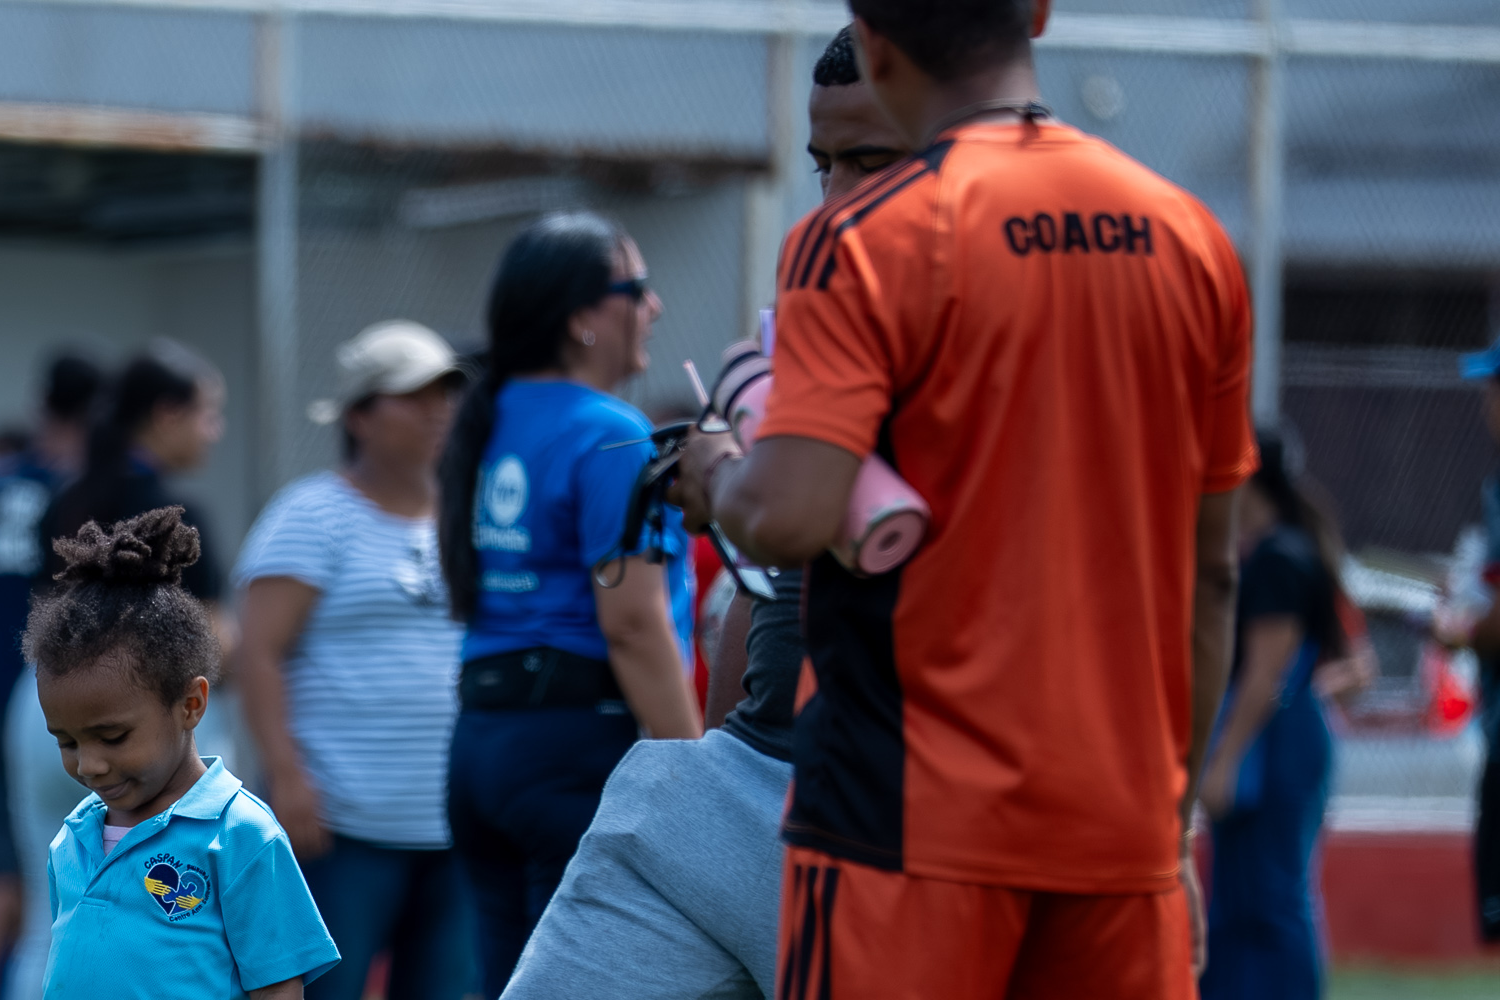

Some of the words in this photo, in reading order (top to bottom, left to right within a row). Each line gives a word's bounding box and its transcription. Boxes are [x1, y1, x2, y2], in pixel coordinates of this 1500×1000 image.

[1004, 212, 1155, 257] COACH
[144, 853, 183, 869] CASPAN
[168, 912, 191, 922] Centro
